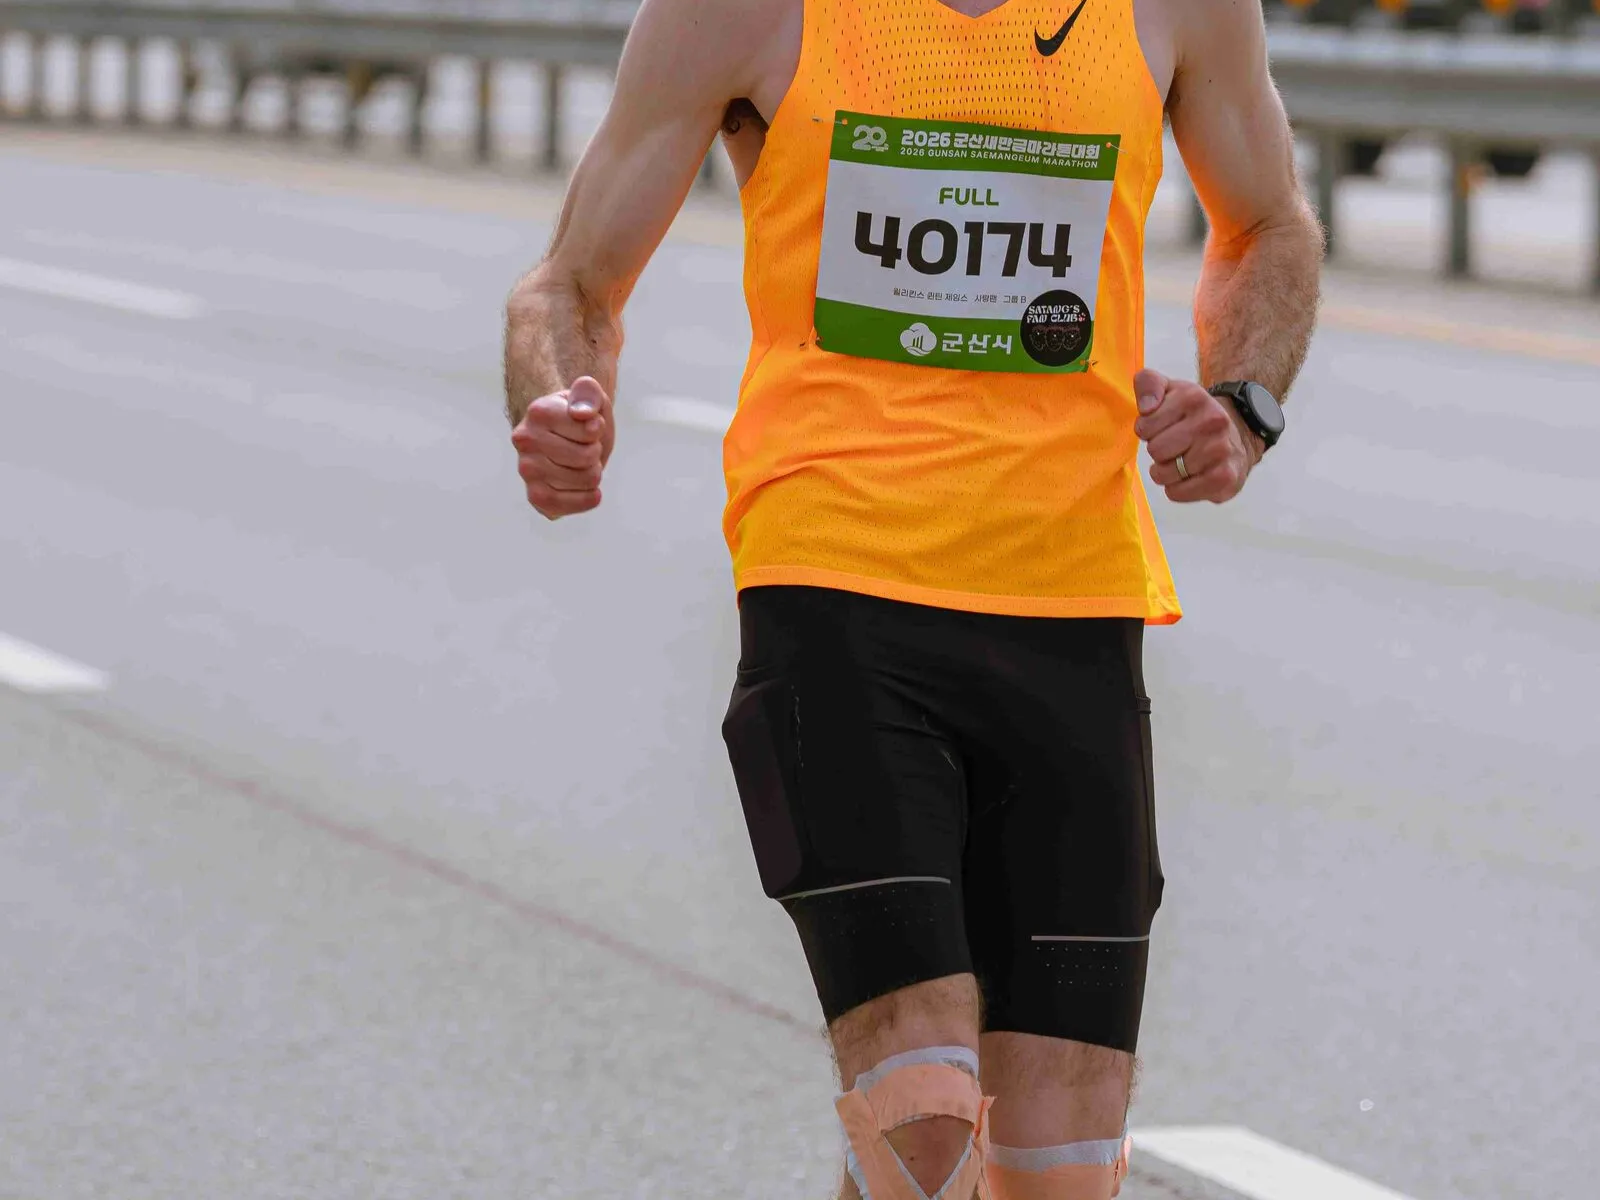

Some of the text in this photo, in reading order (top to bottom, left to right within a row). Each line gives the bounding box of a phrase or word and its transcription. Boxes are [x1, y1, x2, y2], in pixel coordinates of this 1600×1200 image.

[901, 129, 1100, 160] 2026 군산새만금마라톤대회
[900, 147, 925, 157] 2026
[928, 149, 968, 158] GUNSAN
[970, 150, 1040, 164] SAEMANGEUM
[1042, 157, 1098, 169] MARATHON
[938, 187, 999, 206] FULL
[854, 211, 1073, 278] 40174
[945, 292, 968, 302] 제임스
[1026, 313, 1078, 324] FAN CLUB
[1028, 304, 1080, 315] SATANG'S
[942, 332, 1013, 355] 군산시
